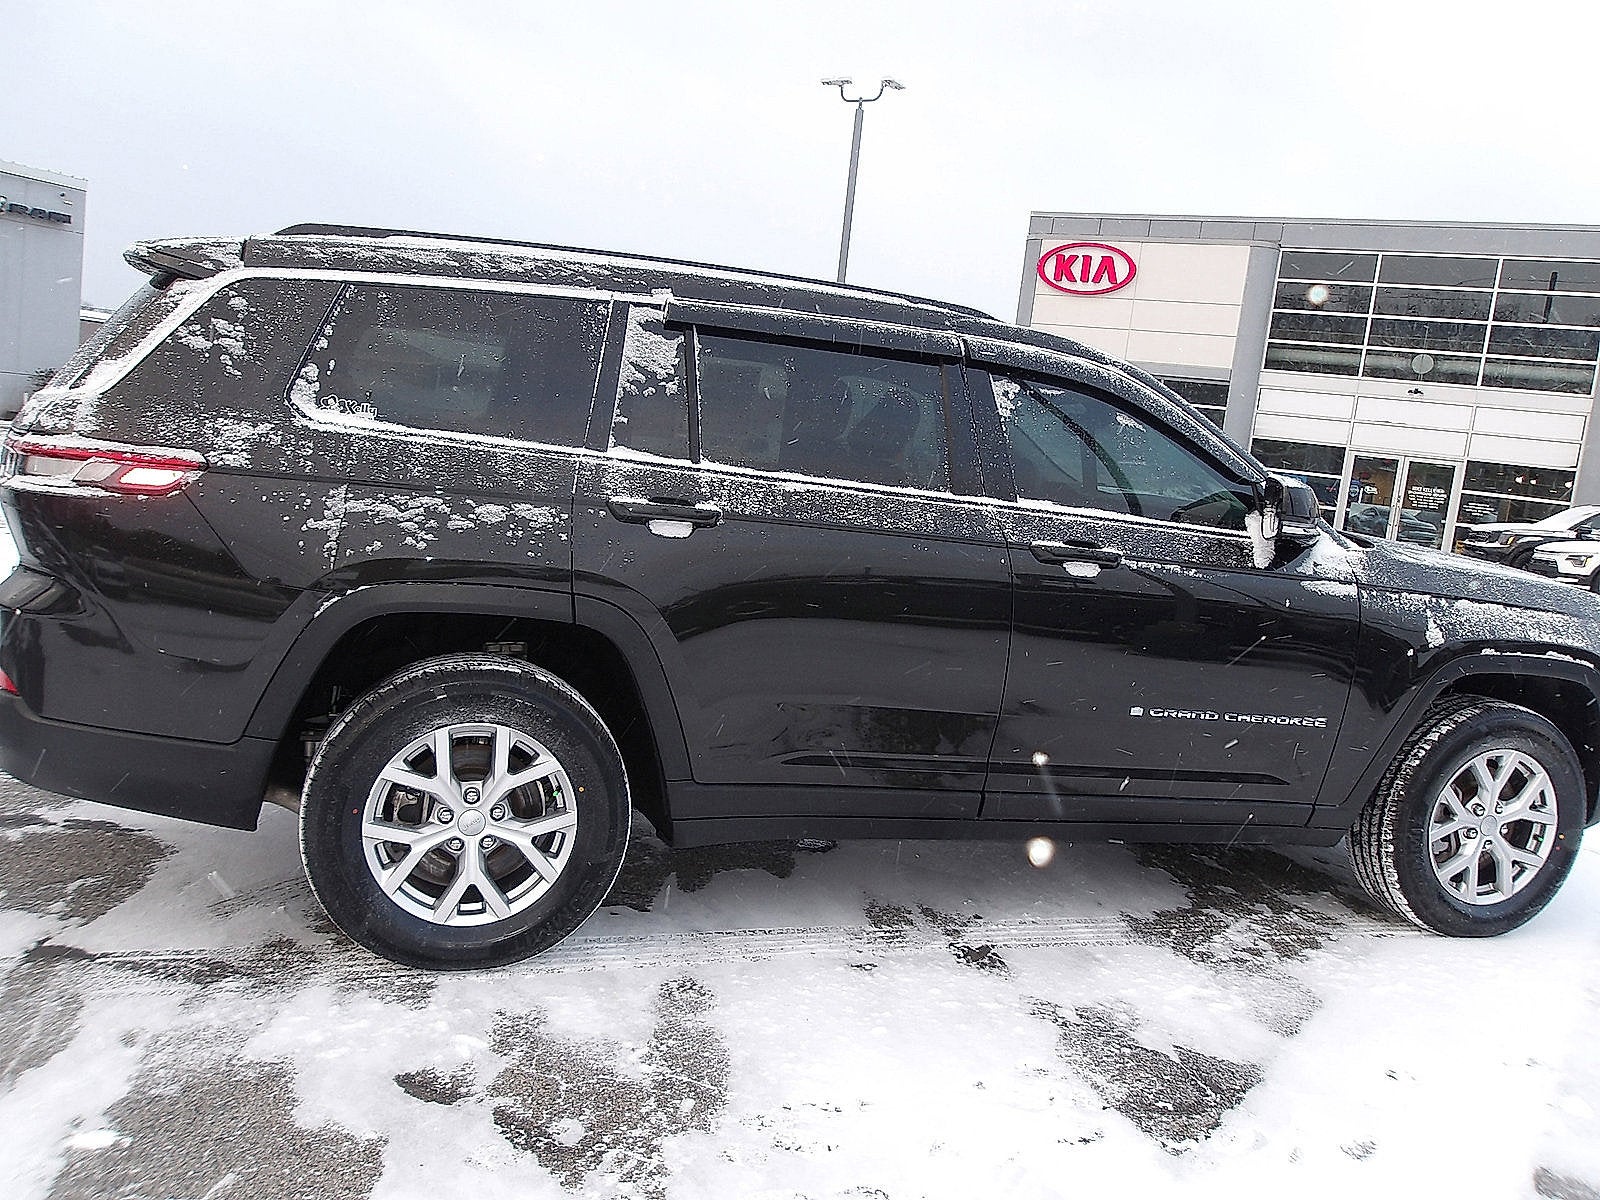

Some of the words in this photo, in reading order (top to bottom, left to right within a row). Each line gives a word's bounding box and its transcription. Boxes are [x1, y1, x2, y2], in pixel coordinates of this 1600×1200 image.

[1053, 253, 1118, 284] KIA
[1149, 707, 1219, 720] GRAND
[1224, 712, 1328, 728] CHEROKEE
